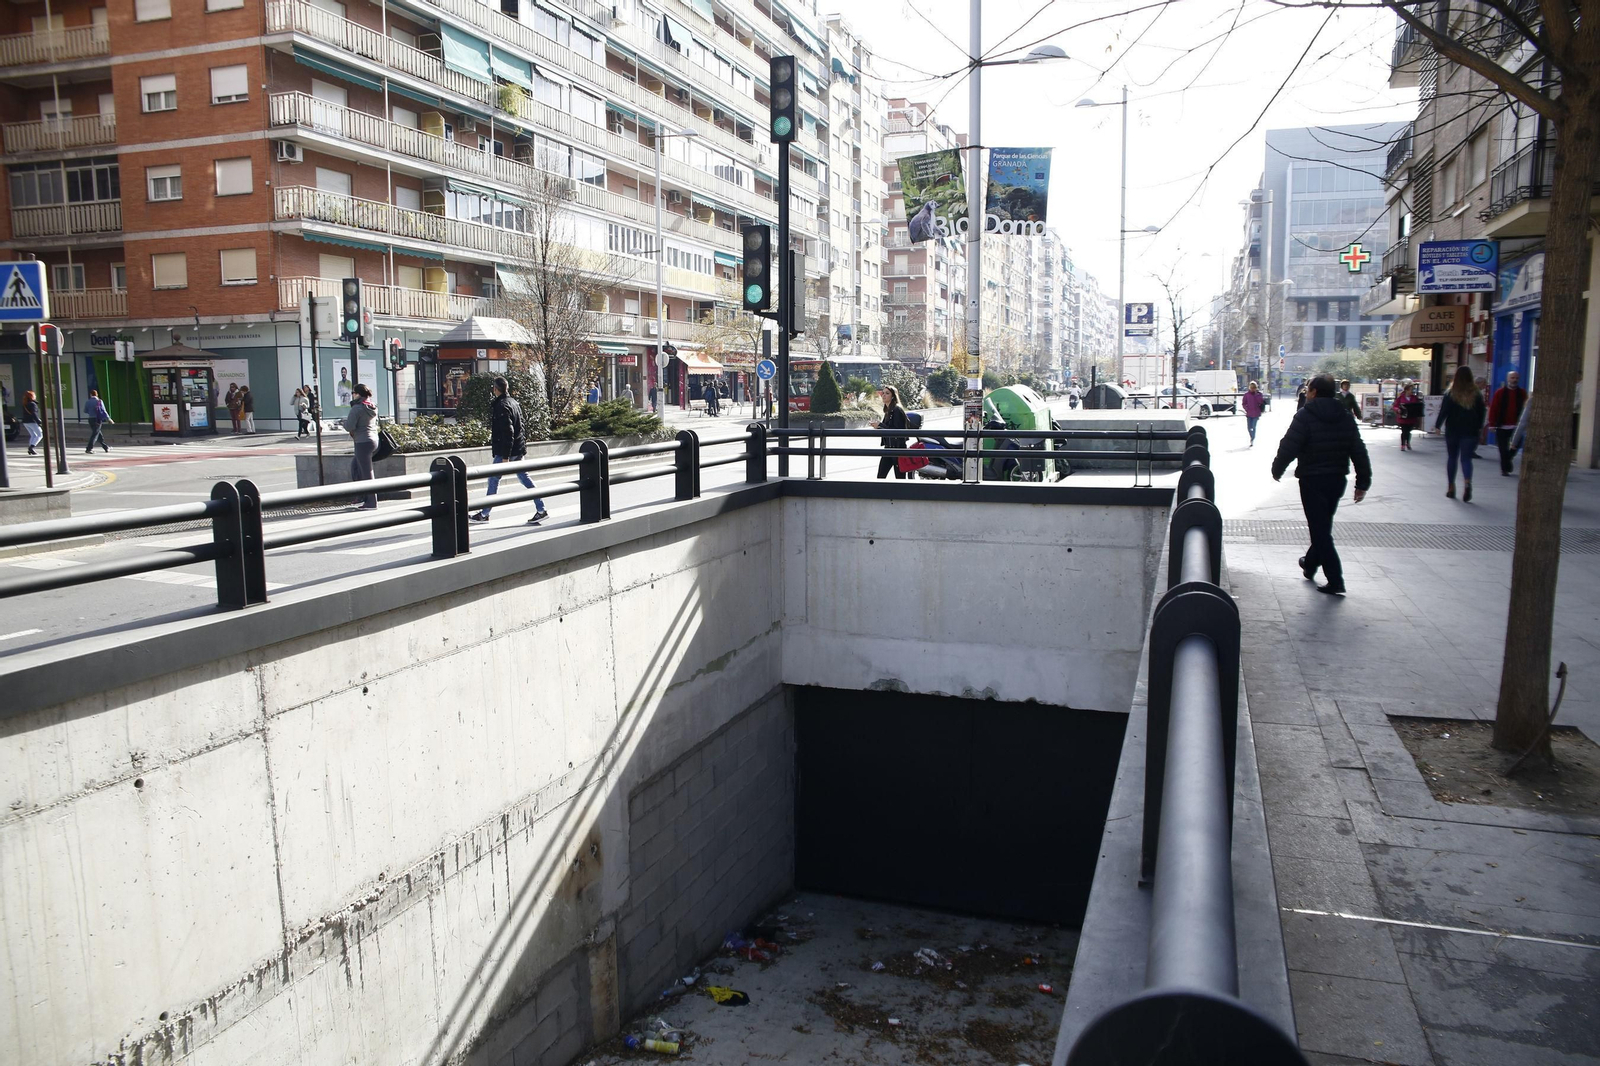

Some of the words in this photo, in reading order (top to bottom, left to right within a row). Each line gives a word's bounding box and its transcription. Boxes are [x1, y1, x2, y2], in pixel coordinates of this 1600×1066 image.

[985, 214, 1046, 236] Domo
[1131, 304, 1148, 322] P
[1429, 311, 1455, 319] CAFE
[1420, 322, 1455, 332] HELADOS
